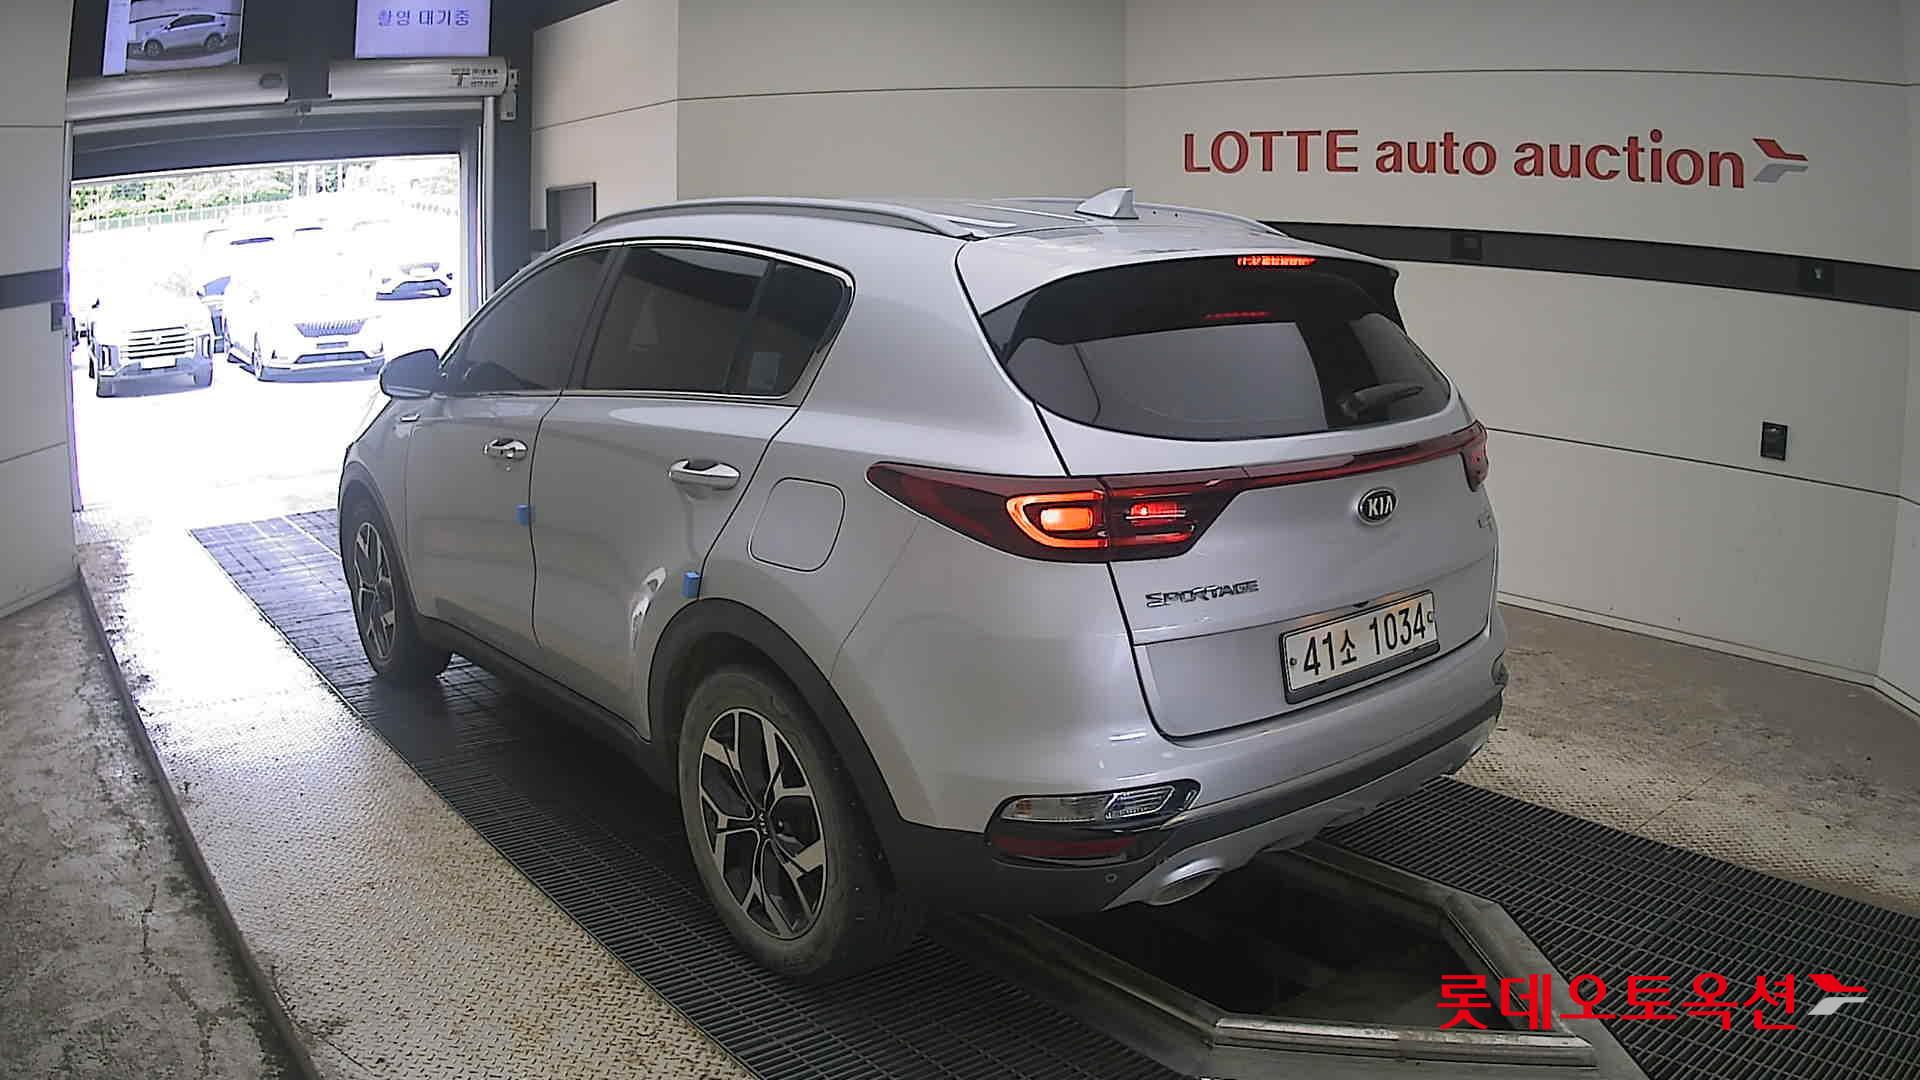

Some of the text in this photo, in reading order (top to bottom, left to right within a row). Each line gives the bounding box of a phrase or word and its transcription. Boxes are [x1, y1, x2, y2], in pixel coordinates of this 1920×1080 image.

[419, 9, 470, 26] 대기중
[1185, 129, 1744, 188] LOTTE auto auction
[1368, 496, 1393, 517] KIA
[1145, 580, 1259, 608] SPORTAGE
[1303, 602, 1426, 675] 41소 1034
